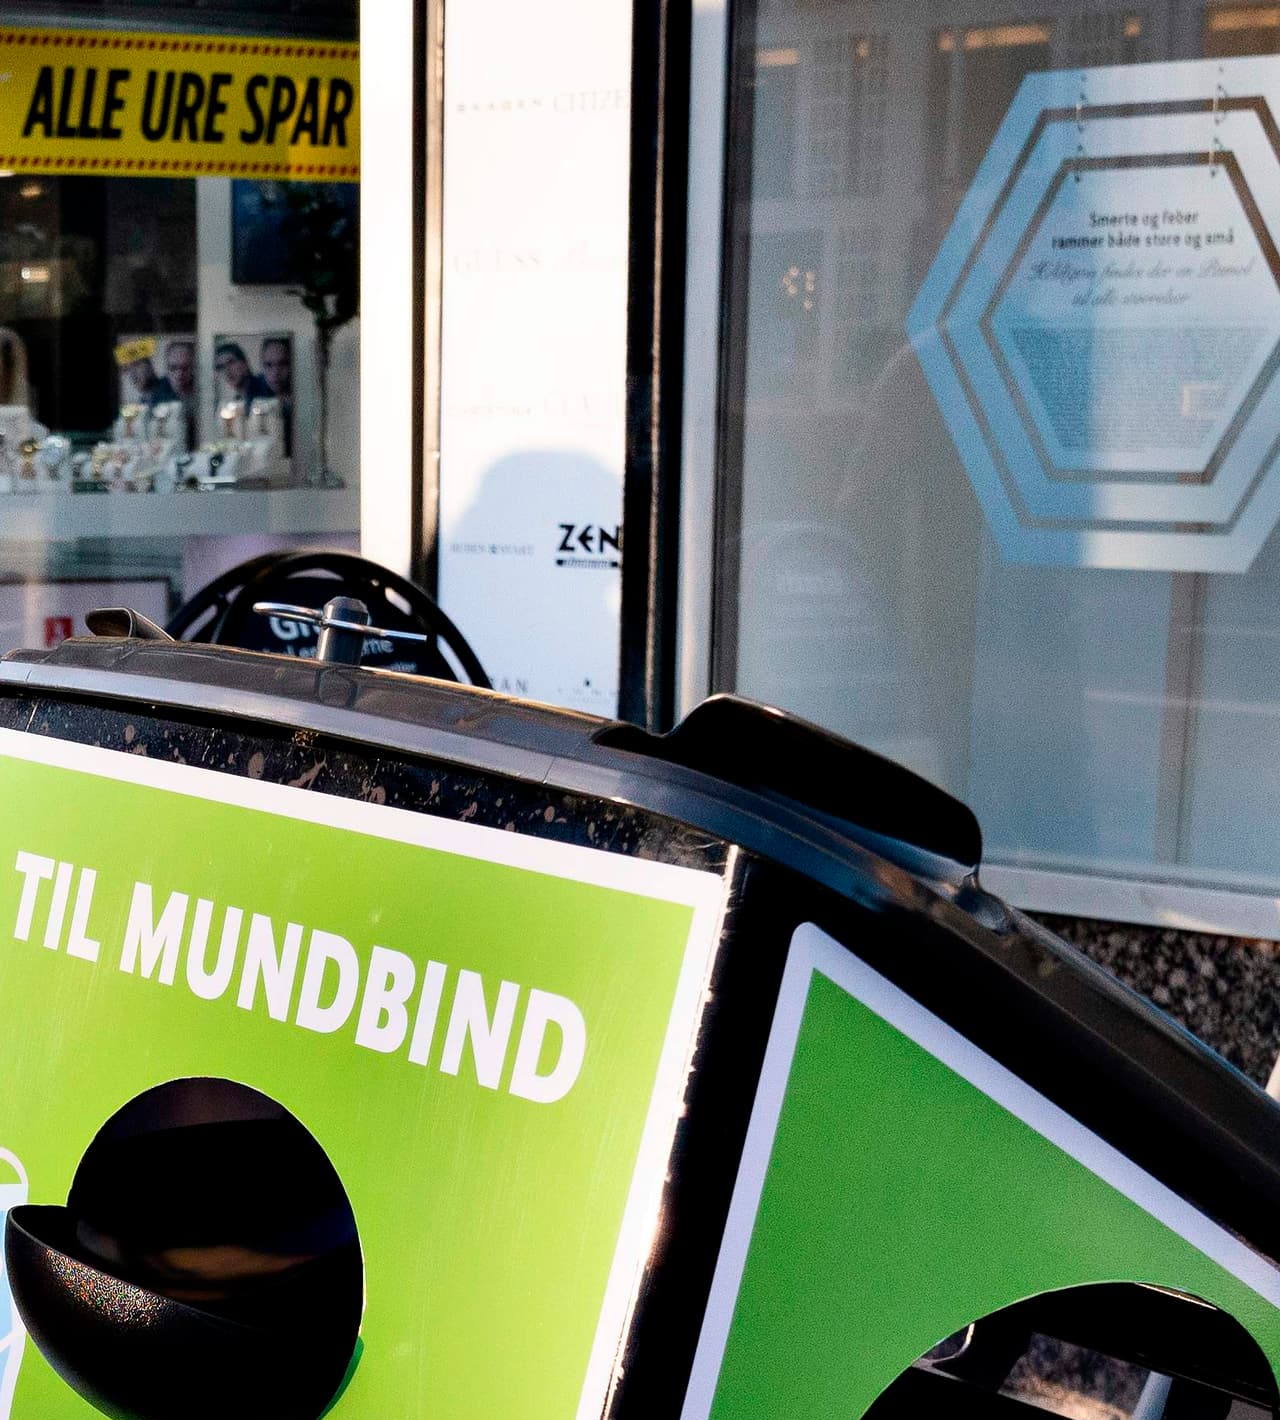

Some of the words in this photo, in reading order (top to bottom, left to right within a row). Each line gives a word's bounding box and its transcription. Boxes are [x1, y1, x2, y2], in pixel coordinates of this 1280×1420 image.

[22, 65, 130, 139] ALLE
[141, 70, 232, 142] URE
[240, 74, 354, 147] SPAR
[14, 850, 101, 963] TIL
[120, 881, 587, 1104] MUNDBIND
